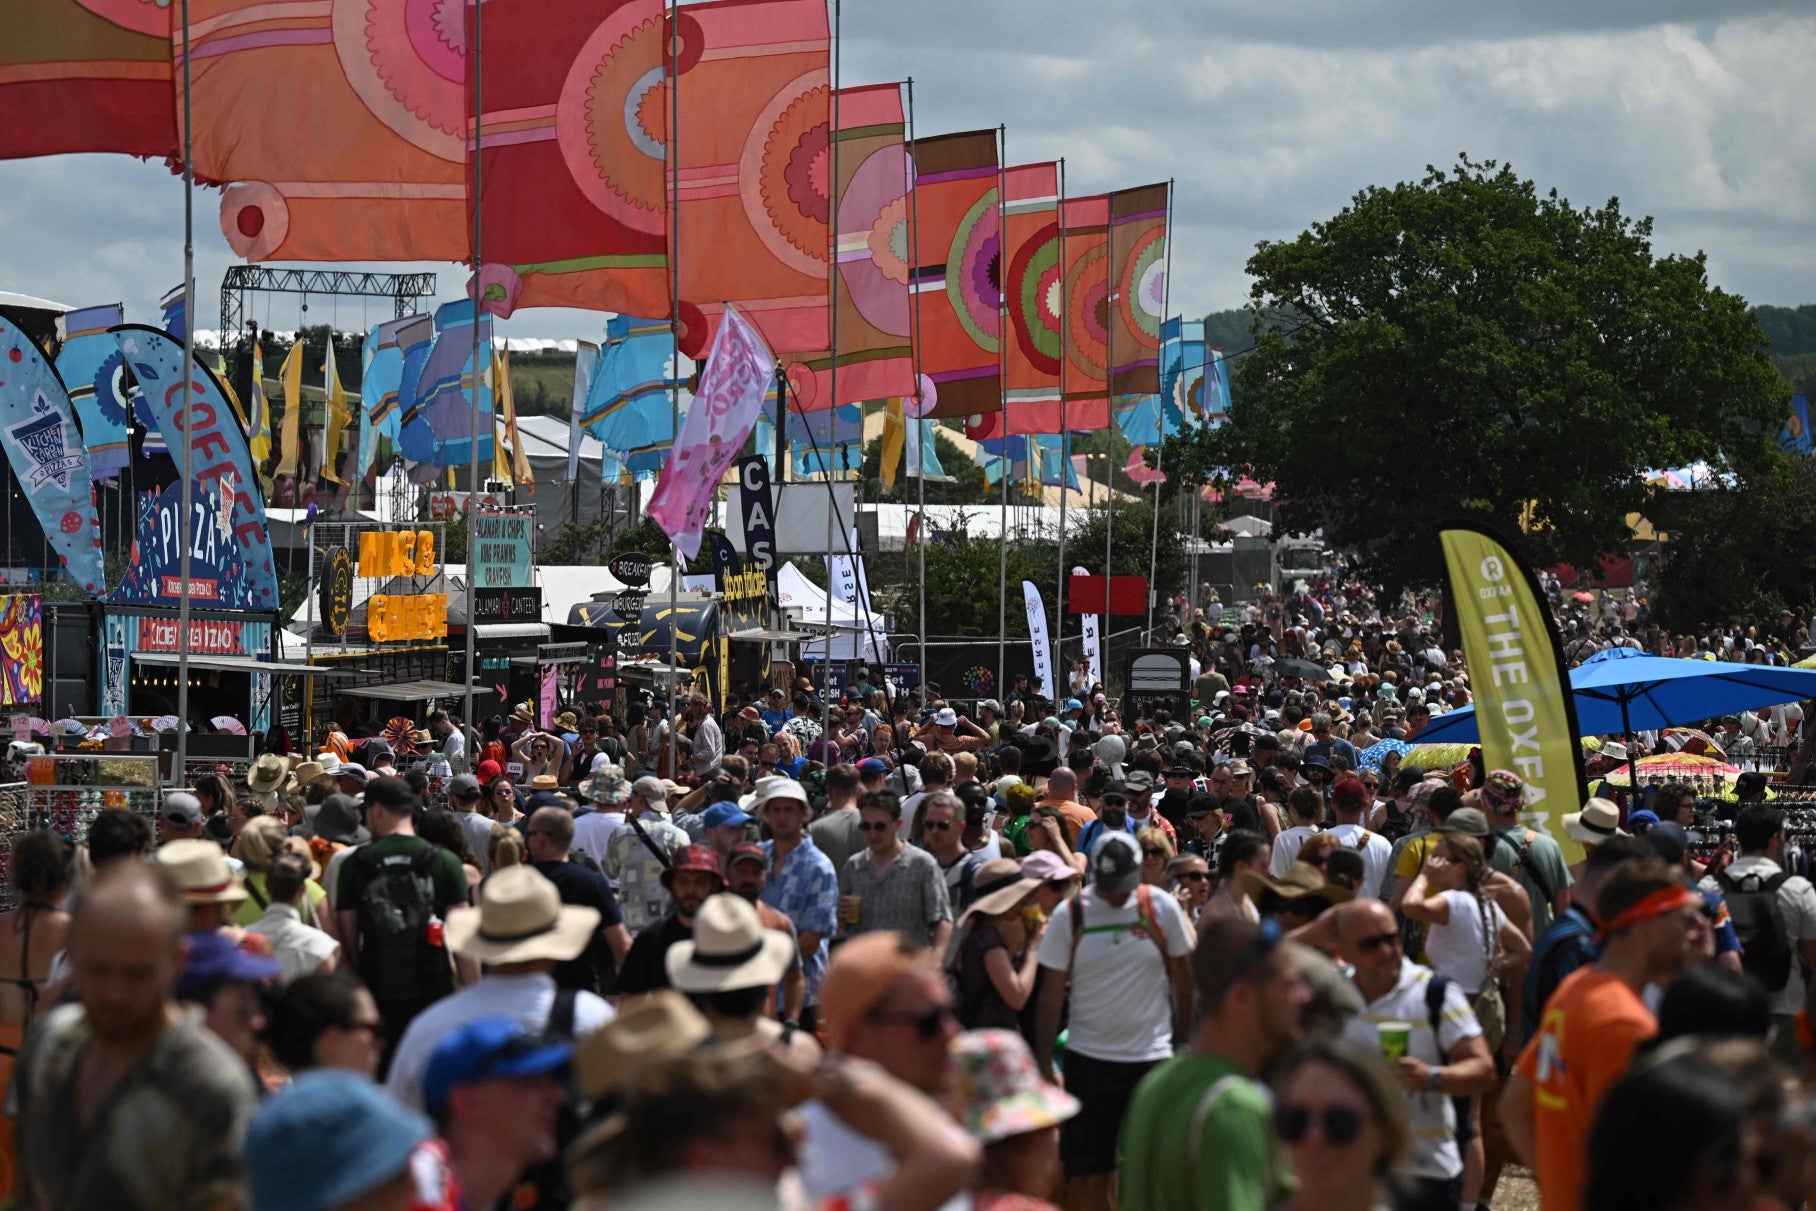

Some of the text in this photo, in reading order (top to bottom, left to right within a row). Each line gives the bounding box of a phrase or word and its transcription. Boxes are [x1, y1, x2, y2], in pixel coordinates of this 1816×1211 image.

[45, 462, 67, 475] PIZZA
[165, 380, 266, 548] COFFEE
[507, 519, 525, 539] CHIPS
[480, 543, 516, 563] KING PRAWNS
[485, 567, 512, 586] CRAYFISH
[618, 561, 652, 578] BREAKFAST
[1479, 585, 1511, 599] OXFAM
[511, 597, 536, 614] CANTEEN
[1484, 605, 1528, 687] THE
[818, 688, 841, 699] CSH
[1502, 699, 1550, 833] OXFAM
